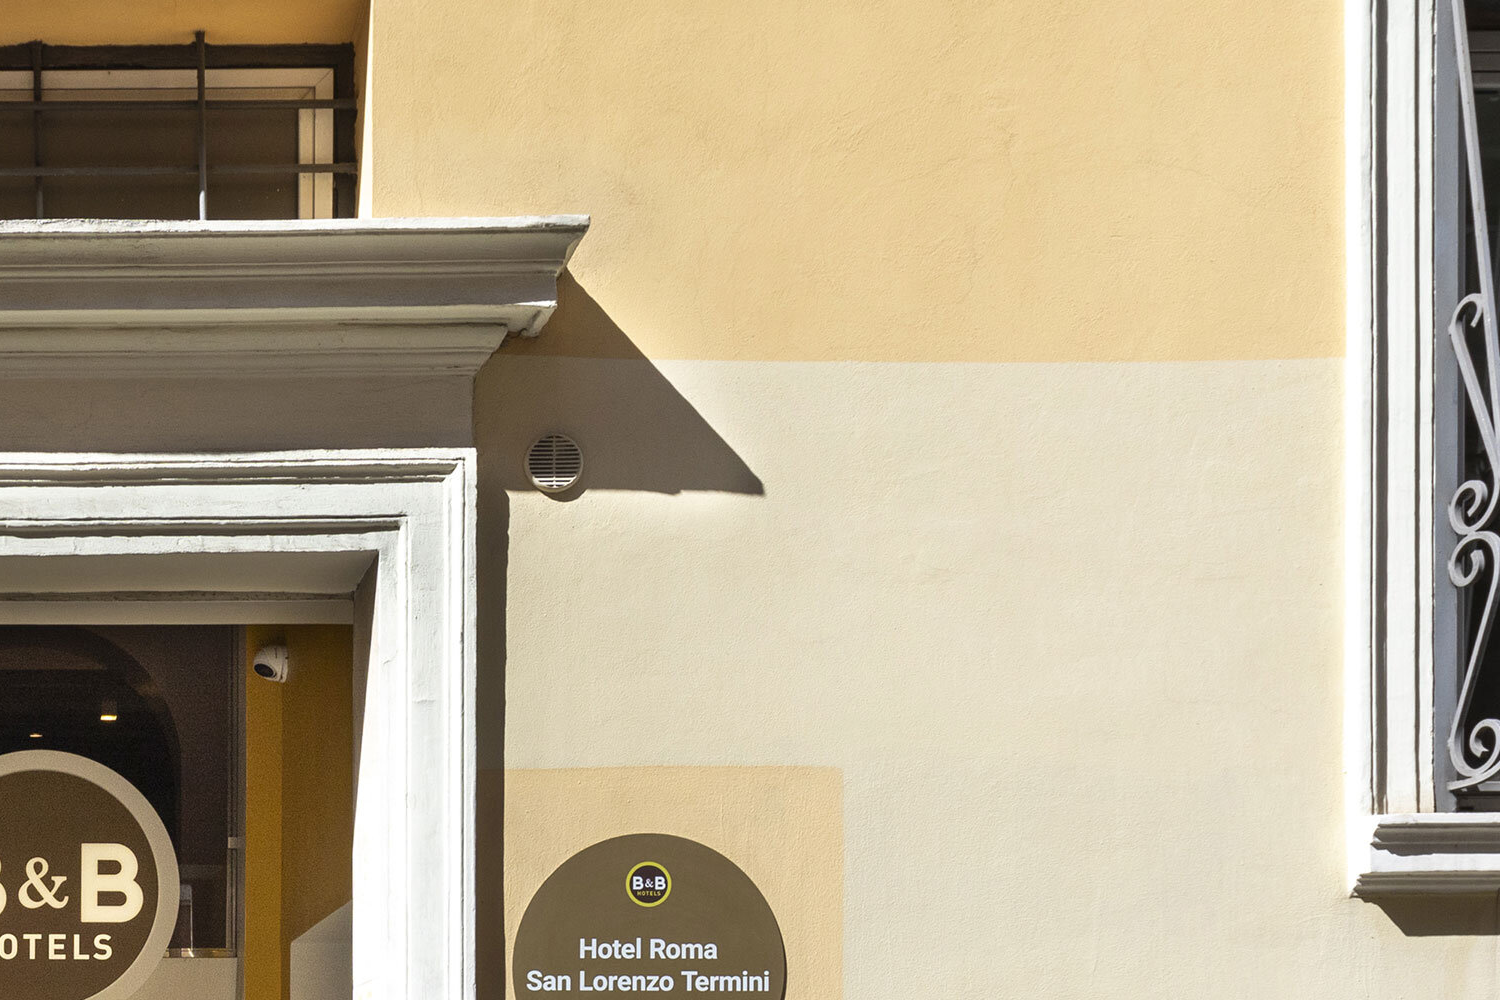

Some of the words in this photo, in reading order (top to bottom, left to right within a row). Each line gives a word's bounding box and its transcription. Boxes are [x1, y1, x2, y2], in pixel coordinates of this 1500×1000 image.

[632, 876, 666, 890] B&B
[579, 937, 642, 960] Hotel
[650, 938, 718, 960] Roma
[526, 970, 572, 992] San
[579, 970, 674, 992] Lorenzo
[680, 970, 770, 992] Termini
